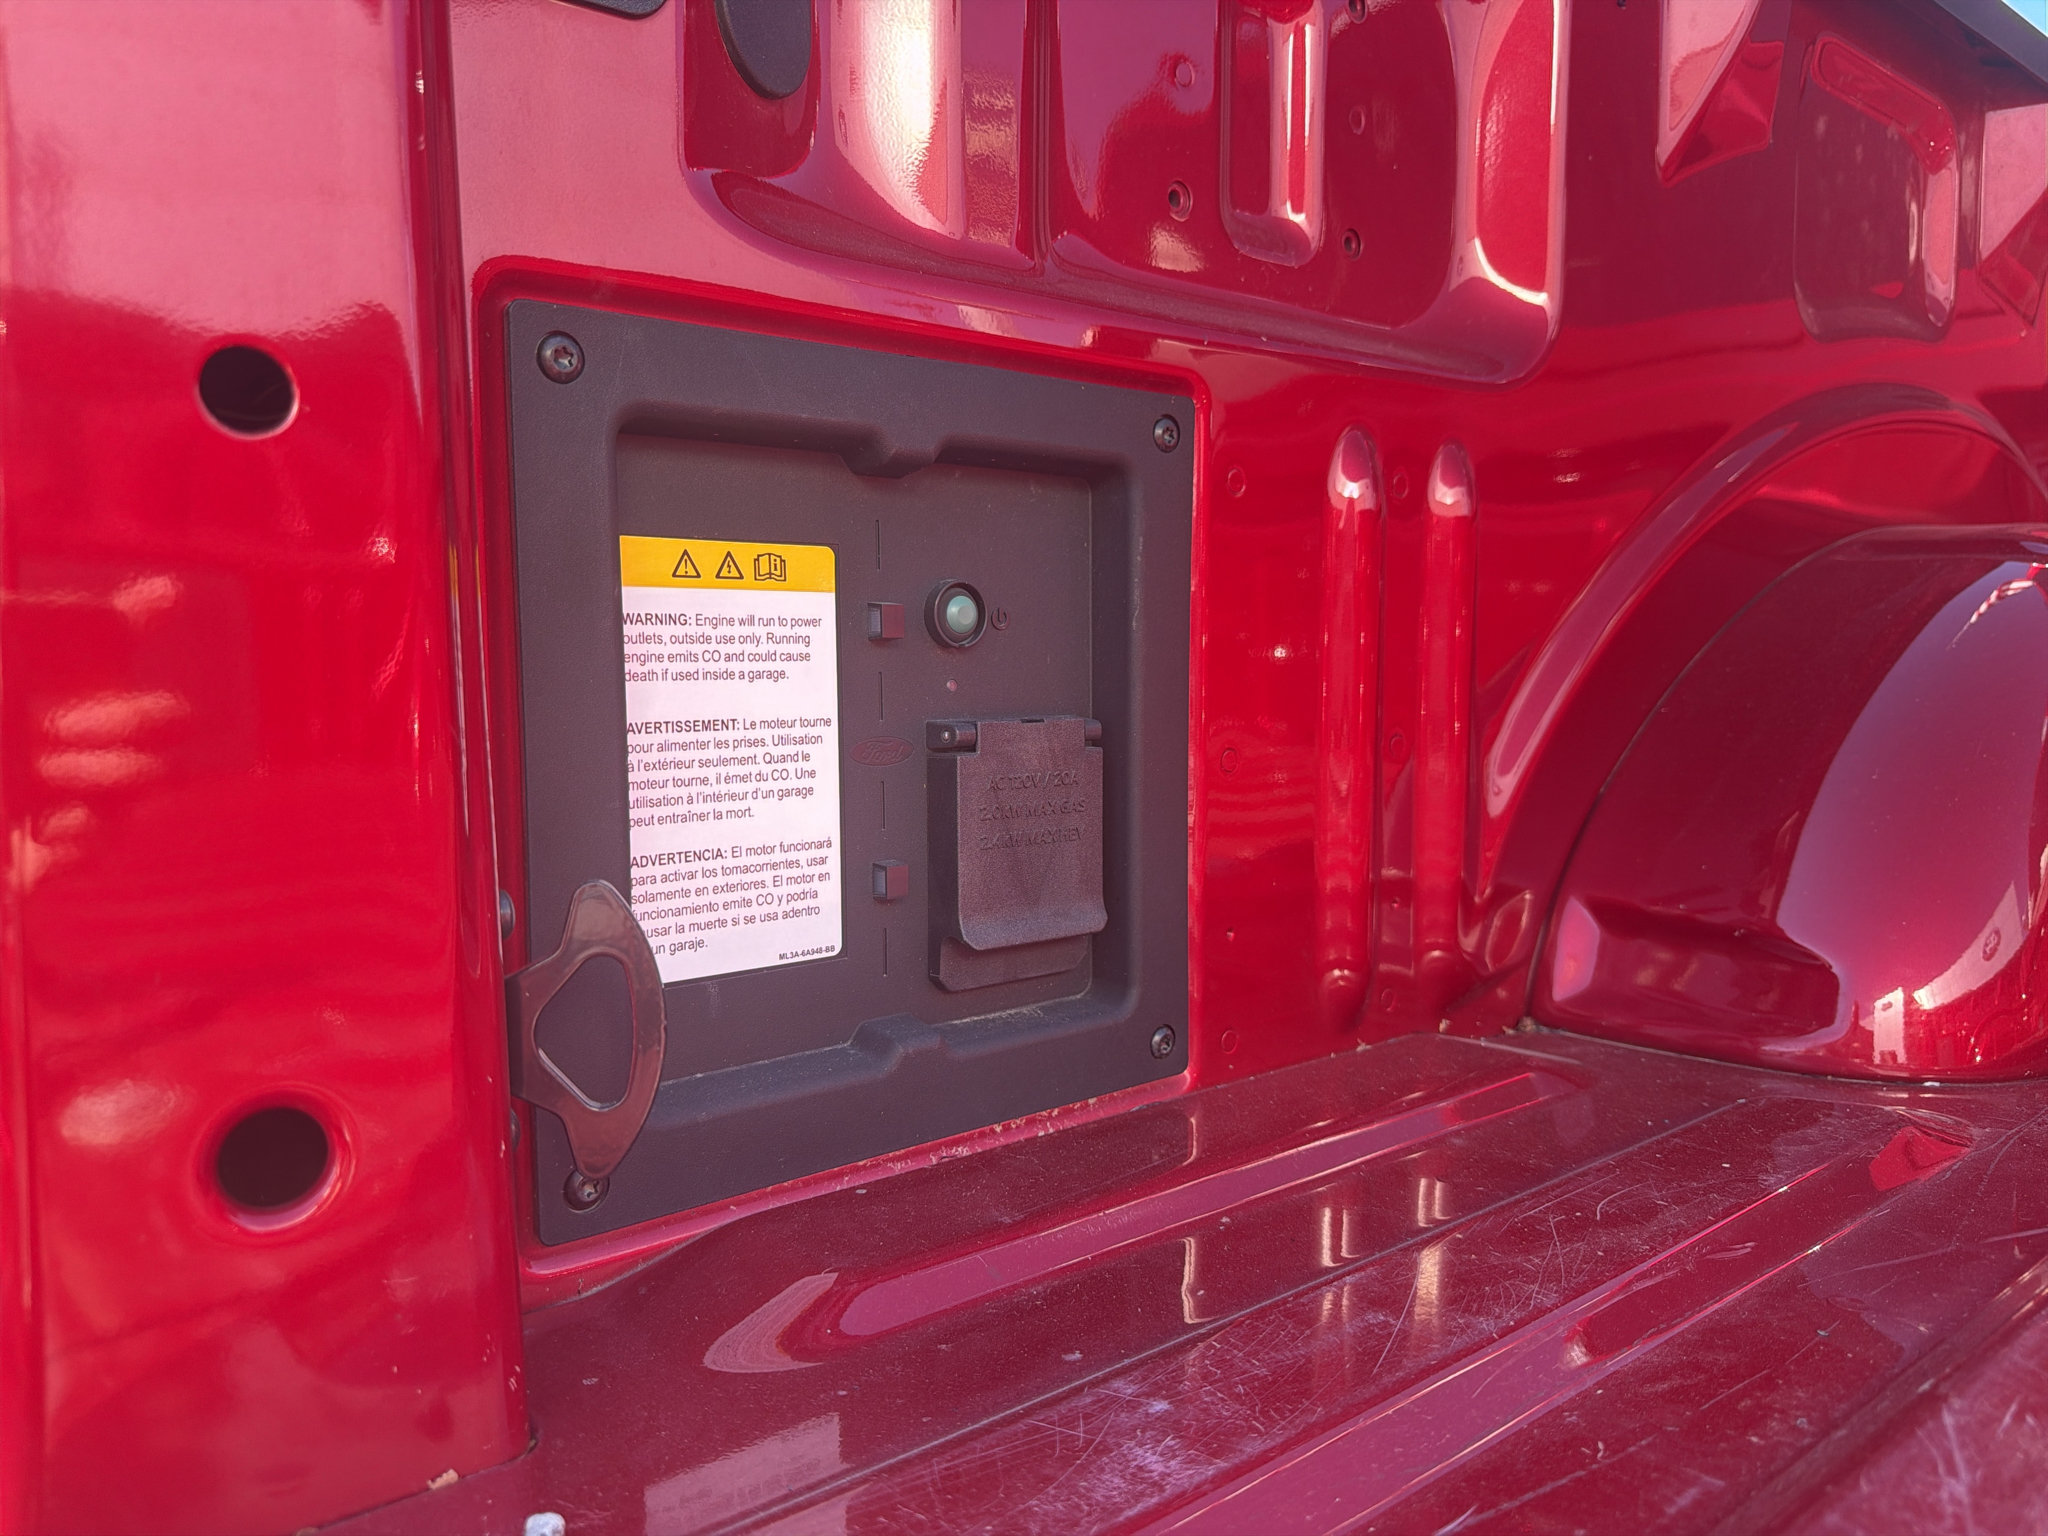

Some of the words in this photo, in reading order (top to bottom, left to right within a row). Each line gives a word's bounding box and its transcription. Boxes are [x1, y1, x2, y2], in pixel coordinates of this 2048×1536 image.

[623, 613, 692, 627] WARNING:
[695, 614, 735, 629] Engine
[738, 615, 755, 627] will
[758, 617, 775, 627] run
[778, 616, 787, 627] to
[791, 617, 822, 629] power
[669, 632, 712, 644] outside
[715, 634, 735, 645] use
[738, 633, 764, 647] only.
[766, 632, 810, 647] Running
[624, 651, 665, 666] engine
[667, 650, 699, 662] emits
[702, 650, 721, 663] CO
[724, 651, 744, 662] and
[748, 650, 776, 662] could
[779, 651, 810, 662] cause
[624, 669, 659, 682] death
[661, 669, 669, 681] if
[671, 669, 699, 681] used
[702, 668, 735, 681] inside
[739, 670, 745, 680] a
[748, 668, 789, 683] garage.
[627, 719, 740, 735] AVERTISSEMENT:
[743, 718, 756, 730] Le
[759, 718, 796, 729] moteur
[800, 717, 832, 728] tourne
[657, 738, 710, 753] alimenter
[714, 738, 729, 749] les
[733, 736, 769, 751] prises.
[772, 733, 823, 747] Utilisation
[628, 760, 634, 772] à
[638, 757, 695, 772] l'extérieur
[698, 753, 760, 768] seulement.
[763, 751, 799, 766] Quand
[801, 750, 810, 762] le
[629, 778, 669, 791] moteur
[672, 773, 713, 789] tourne,
[715, 773, 721, 785] il
[724, 771, 752, 784] émet
[755, 769, 768, 782] du
[771, 769, 792, 782] CO.
[795, 768, 816, 779] Une
[687, 793, 693, 805] à
[697, 791, 748, 804] l'intérieur
[752, 788, 775, 800] d'un
[777, 785, 814, 801] garage
[658, 809, 710, 825] entraîner
[713, 808, 723, 820] la
[726, 806, 755, 819] mort.
[631, 848, 728, 869] ADVERTENCIA:
[731, 846, 742, 858] El
[745, 843, 776, 857] motor
[780, 837, 832, 853] funcionará
[661, 869, 699, 883] activar
[702, 866, 718, 878] los
[721, 858, 804, 876] tomacorrientes,
[806, 854, 829, 867] usar
[631, 887, 691, 905] solamente
[695, 884, 709, 896] en
[713, 878, 769, 894] exteriores.
[773, 875, 783, 888] El
[786, 873, 815, 887] motor
[818, 872, 830, 882] en
[722, 896, 752, 911] emite
[756, 893, 774, 906] CO
[777, 894, 783, 906] y
[786, 888, 818, 905] podría
[675, 922, 685, 934] la
[689, 917, 728, 933] muerte
[731, 914, 741, 926] si
[743, 914, 756, 925] se
[759, 910, 779, 923] usa
[782, 905, 821, 920] adentro
[669, 936, 708, 956] garaje.
